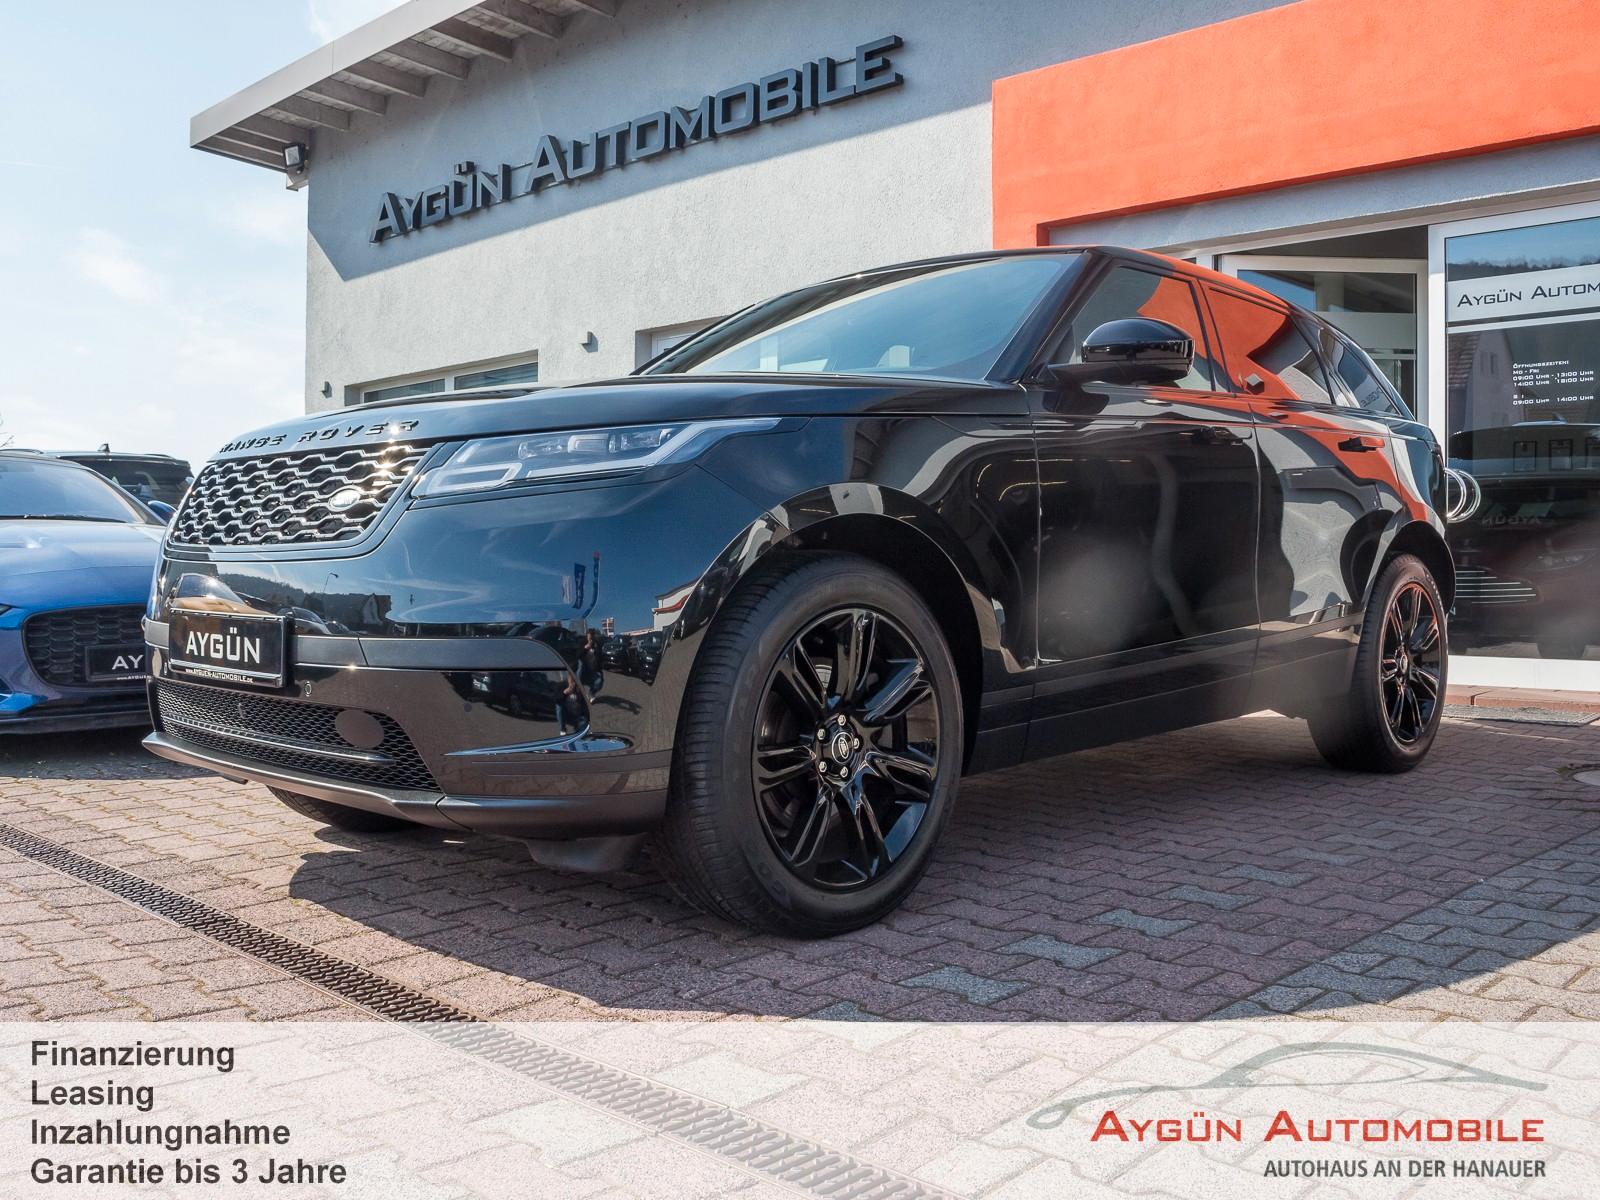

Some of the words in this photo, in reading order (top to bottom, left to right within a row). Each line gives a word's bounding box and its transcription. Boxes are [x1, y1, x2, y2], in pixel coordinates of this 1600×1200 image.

[369, 161, 511, 244] AYGÜN
[526, 35, 903, 193] AUTOMOBILE
[1457, 289, 1522, 307] AYGÜN
[297, 419, 419, 442] ROVER
[185, 626, 261, 664] AYGÜN
